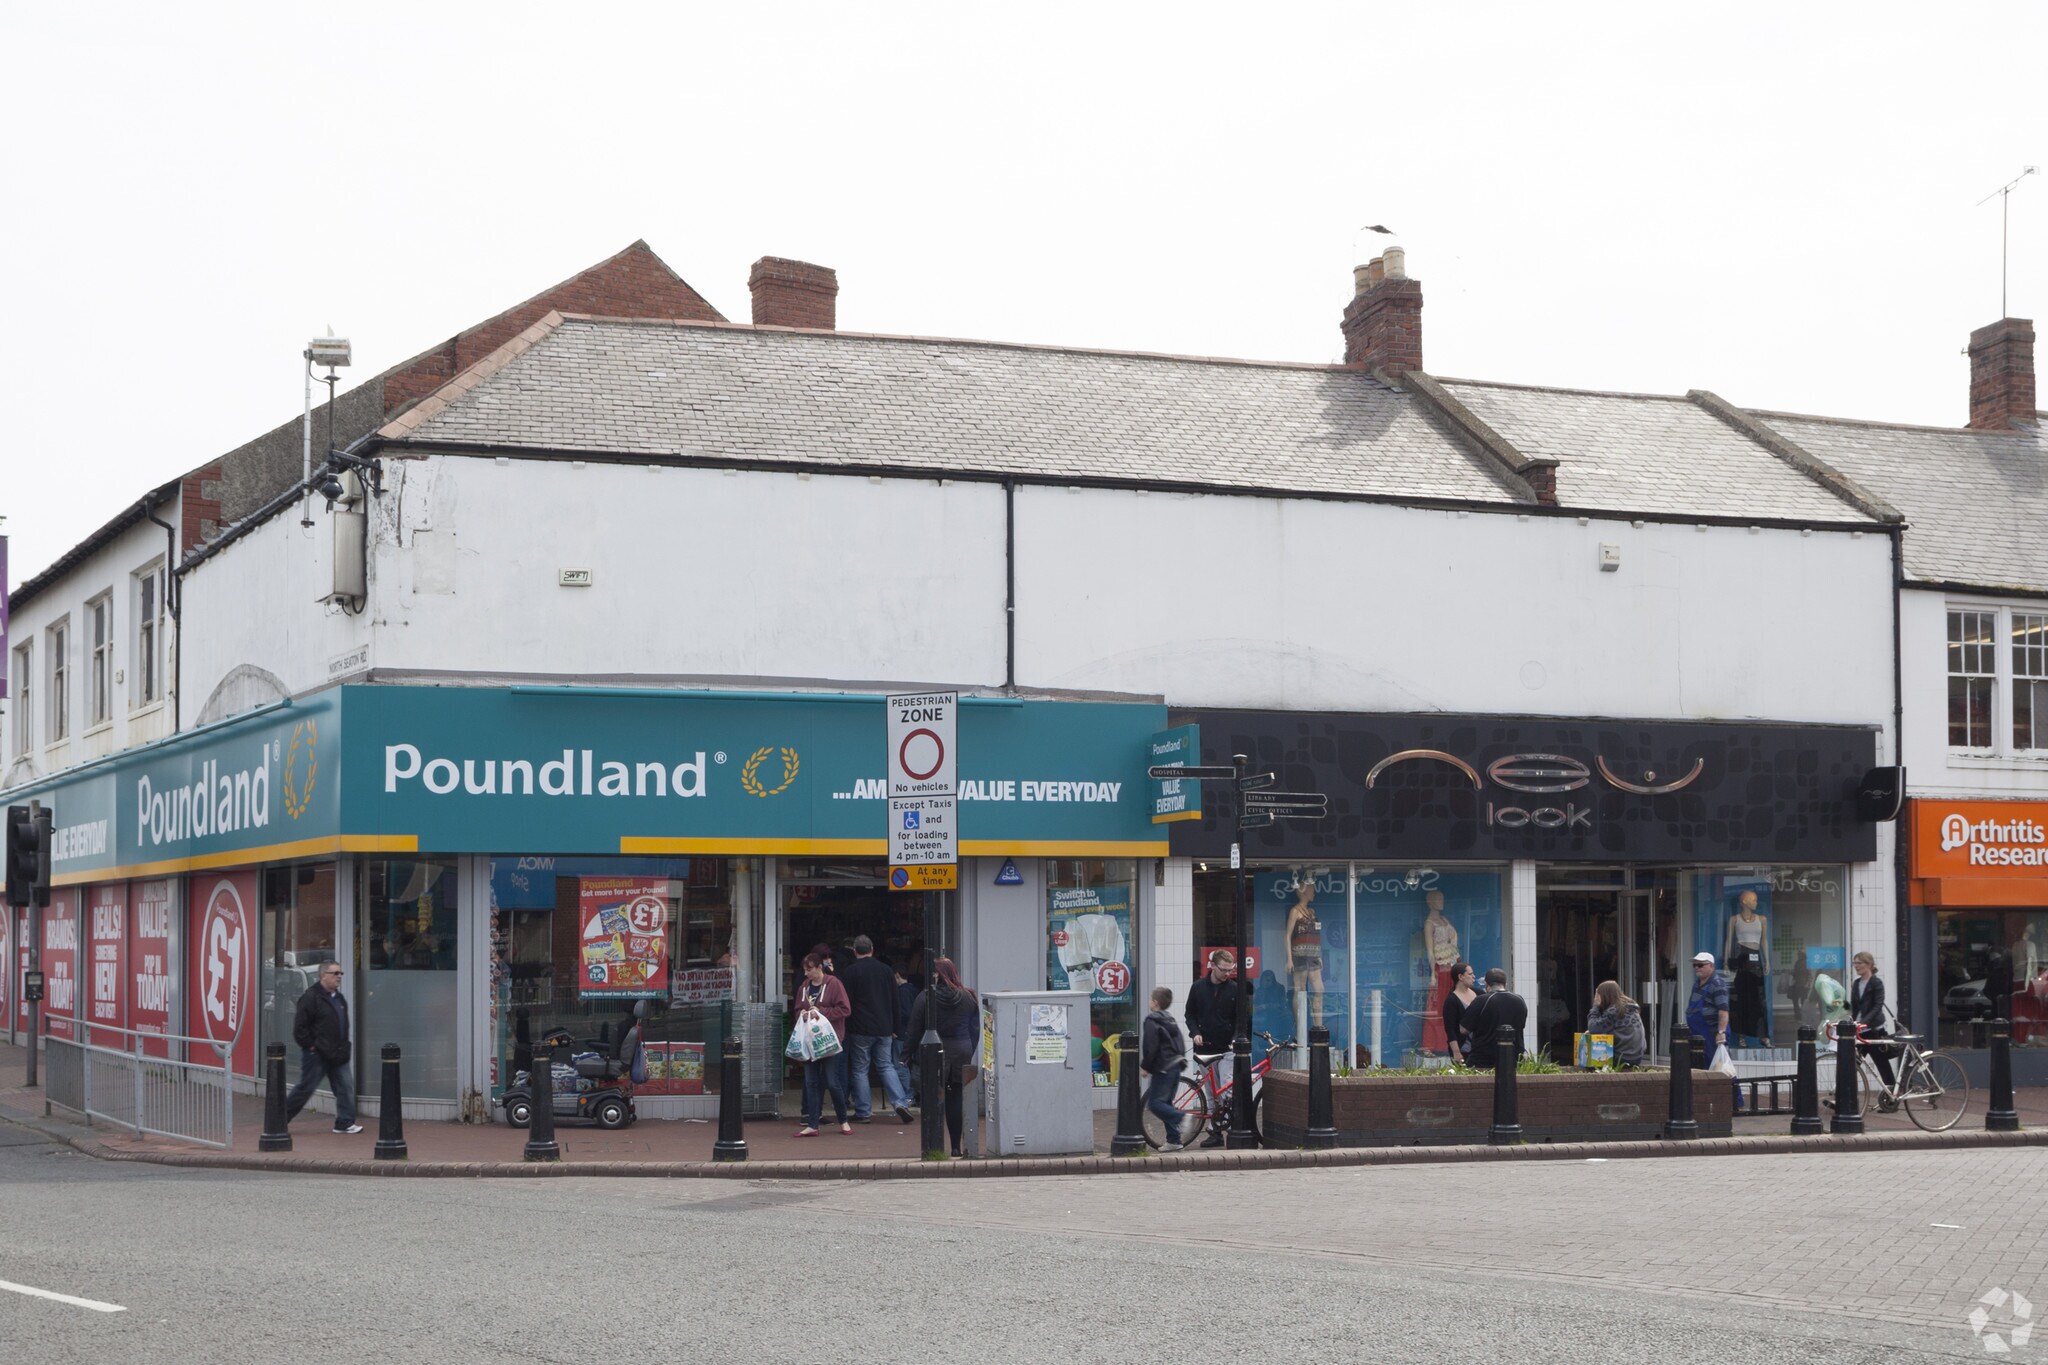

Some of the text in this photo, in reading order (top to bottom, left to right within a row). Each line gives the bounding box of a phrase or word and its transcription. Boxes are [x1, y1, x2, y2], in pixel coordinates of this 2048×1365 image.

[329, 660, 342, 673] NORTH
[343, 654, 359, 669] SEATON
[892, 696, 951, 707] PEDESTRIAN
[901, 708, 943, 723] ZONE
[896, 782, 948, 792] No vehicles
[1021, 781, 1122, 802] EVERYDAY
[1162, 779, 1181, 795] VALUE
[893, 800, 952, 810] Except Taxis
[1156, 795, 1185, 813] EVERYDAY
[926, 815, 942, 824] and
[1486, 802, 1592, 828] look
[70, 819, 107, 858] EVERYDAY
[898, 831, 948, 840] for loading
[1941, 814, 2045, 851] Arthritis
[904, 842, 942, 850] between
[1970, 843, 2048, 865] Resear
[896, 852, 902, 860] 4
[918, 867, 948, 876] At any
[582, 879, 634, 889] Poundland
[625, 888, 641, 896] your
[642, 886, 667, 894] Pound!
[1053, 897, 1100, 909] Poundland
[1055, 889, 1095, 900] Switch to
[93, 905, 122, 940] DEALS!
[139, 902, 168, 938] VALUE
[634, 904, 660, 927] £1
[95, 962, 117, 1001] NEW
[207, 916, 241, 1031] £1
[1102, 969, 1125, 989] £1
[49, 978, 73, 1010] TODAY!
[136, 974, 168, 1012] TODAY!
